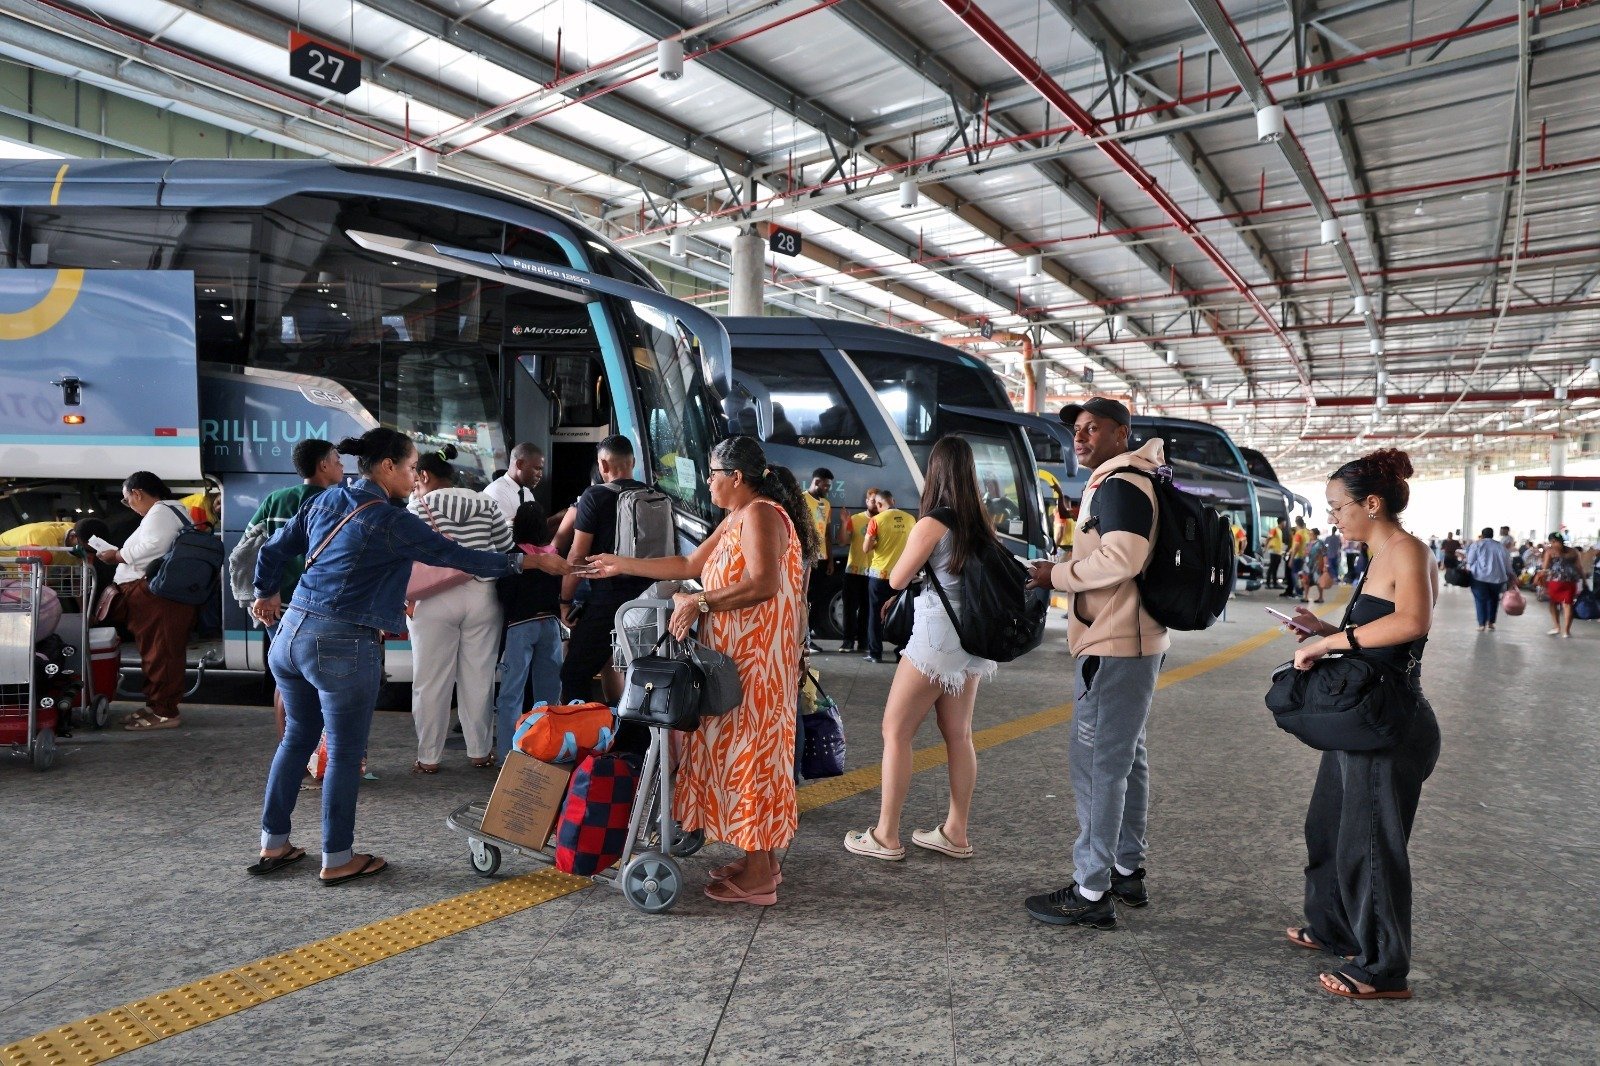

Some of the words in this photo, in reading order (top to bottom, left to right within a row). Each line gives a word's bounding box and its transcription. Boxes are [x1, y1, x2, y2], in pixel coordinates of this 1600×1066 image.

[308, 49, 345, 84] 27
[777, 232, 795, 252] 28
[513, 260, 559, 276] Paradiso
[523, 326, 588, 335] Marcopolo
[807, 437, 861, 446] Marcopolo
